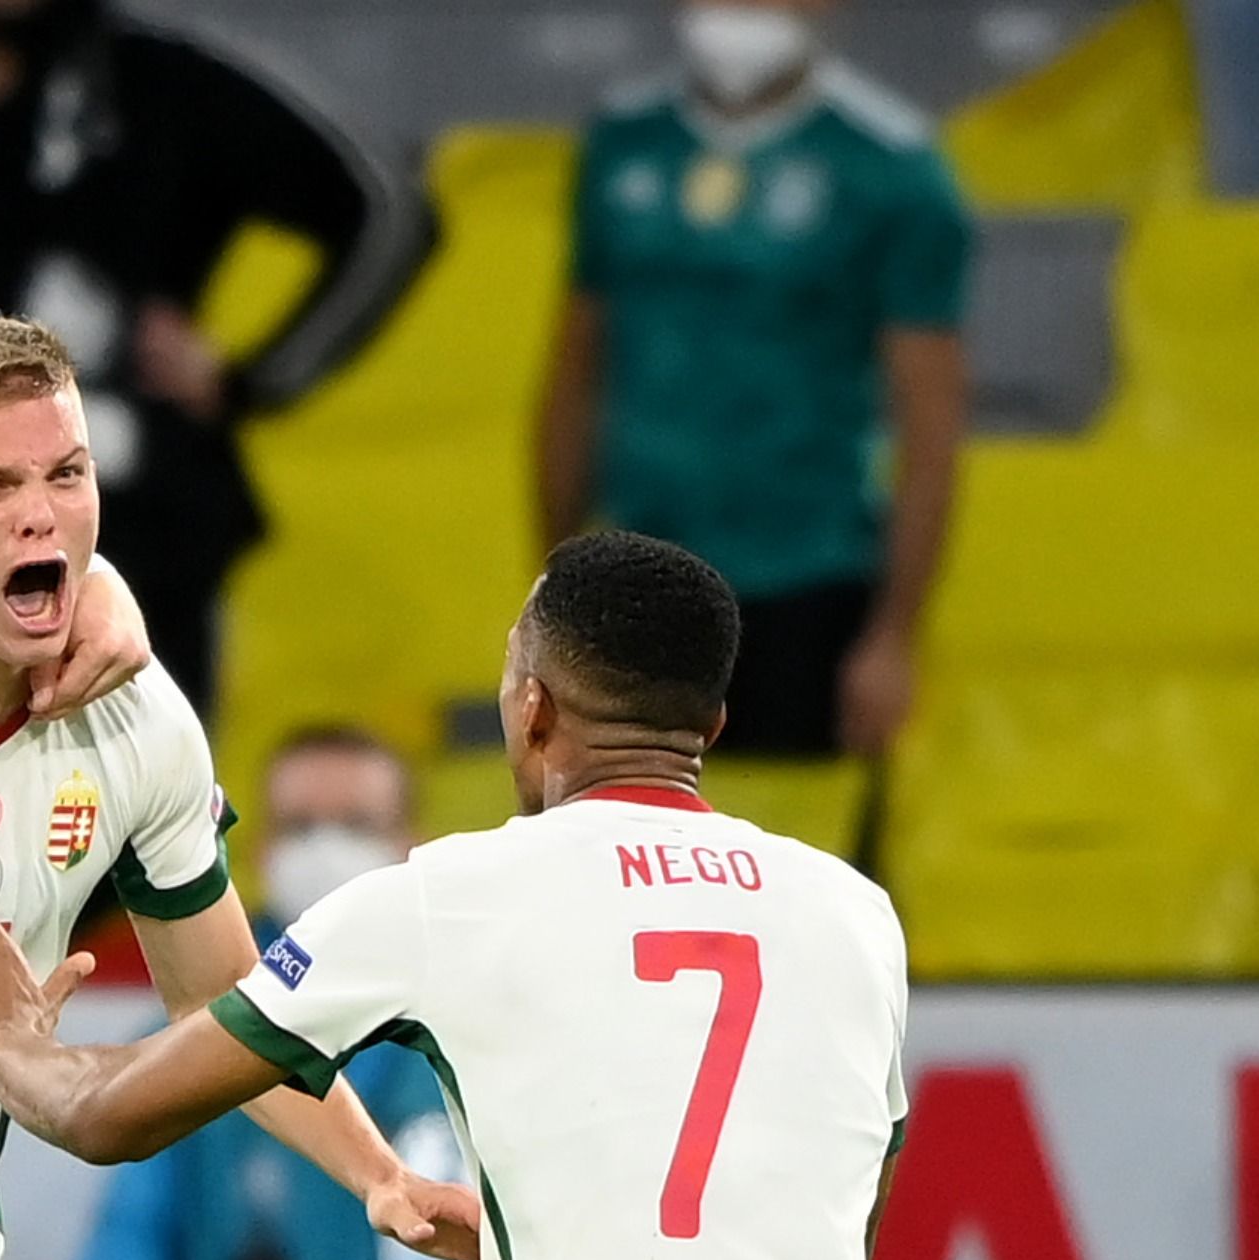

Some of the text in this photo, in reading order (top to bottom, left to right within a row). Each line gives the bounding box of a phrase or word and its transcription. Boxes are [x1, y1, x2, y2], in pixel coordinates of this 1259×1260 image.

[615, 844, 762, 891] NEGO
[264, 940, 306, 982] SPECT
[632, 930, 762, 1239] 7
